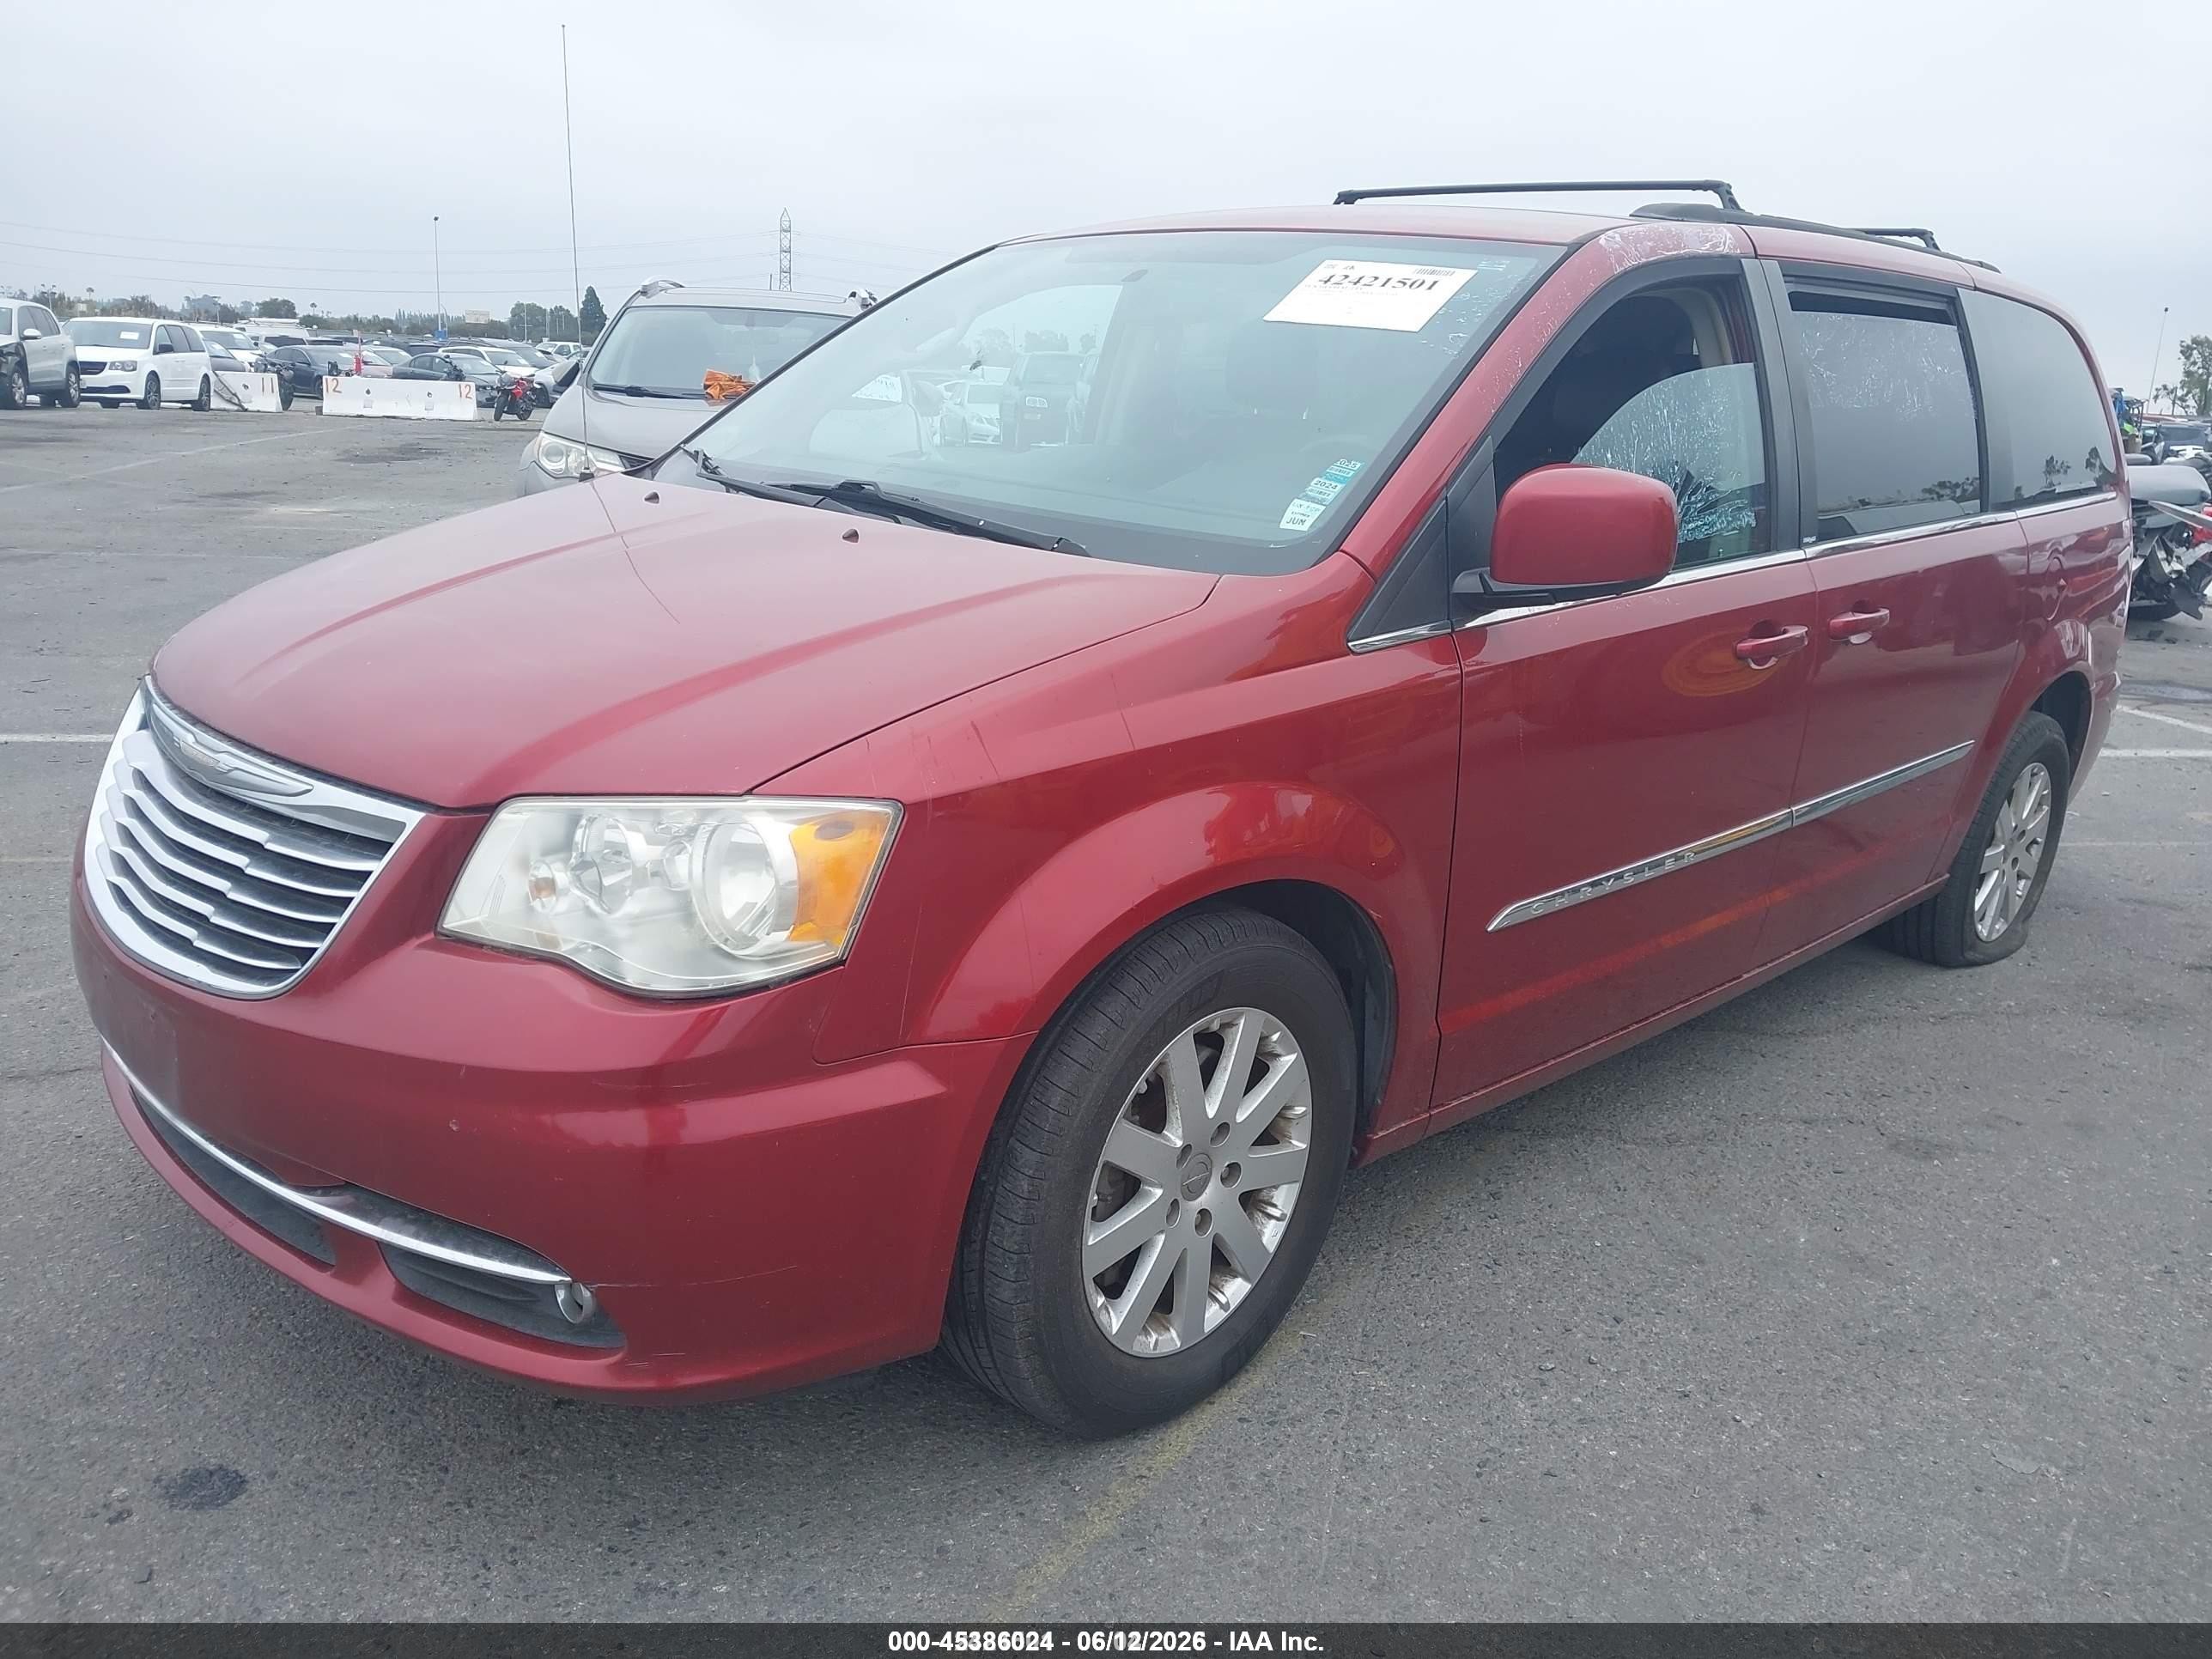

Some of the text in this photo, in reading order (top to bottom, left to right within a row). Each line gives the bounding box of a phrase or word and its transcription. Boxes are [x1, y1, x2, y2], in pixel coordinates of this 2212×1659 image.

[1317, 273, 1440, 291] 42421501
[325, 377, 343, 394] 12
[458, 383, 473, 399] 12
[1313, 480, 1338, 489] 2024
[1285, 516, 1307, 526] JUN
[1530, 851, 1698, 915] CHRYSLER
